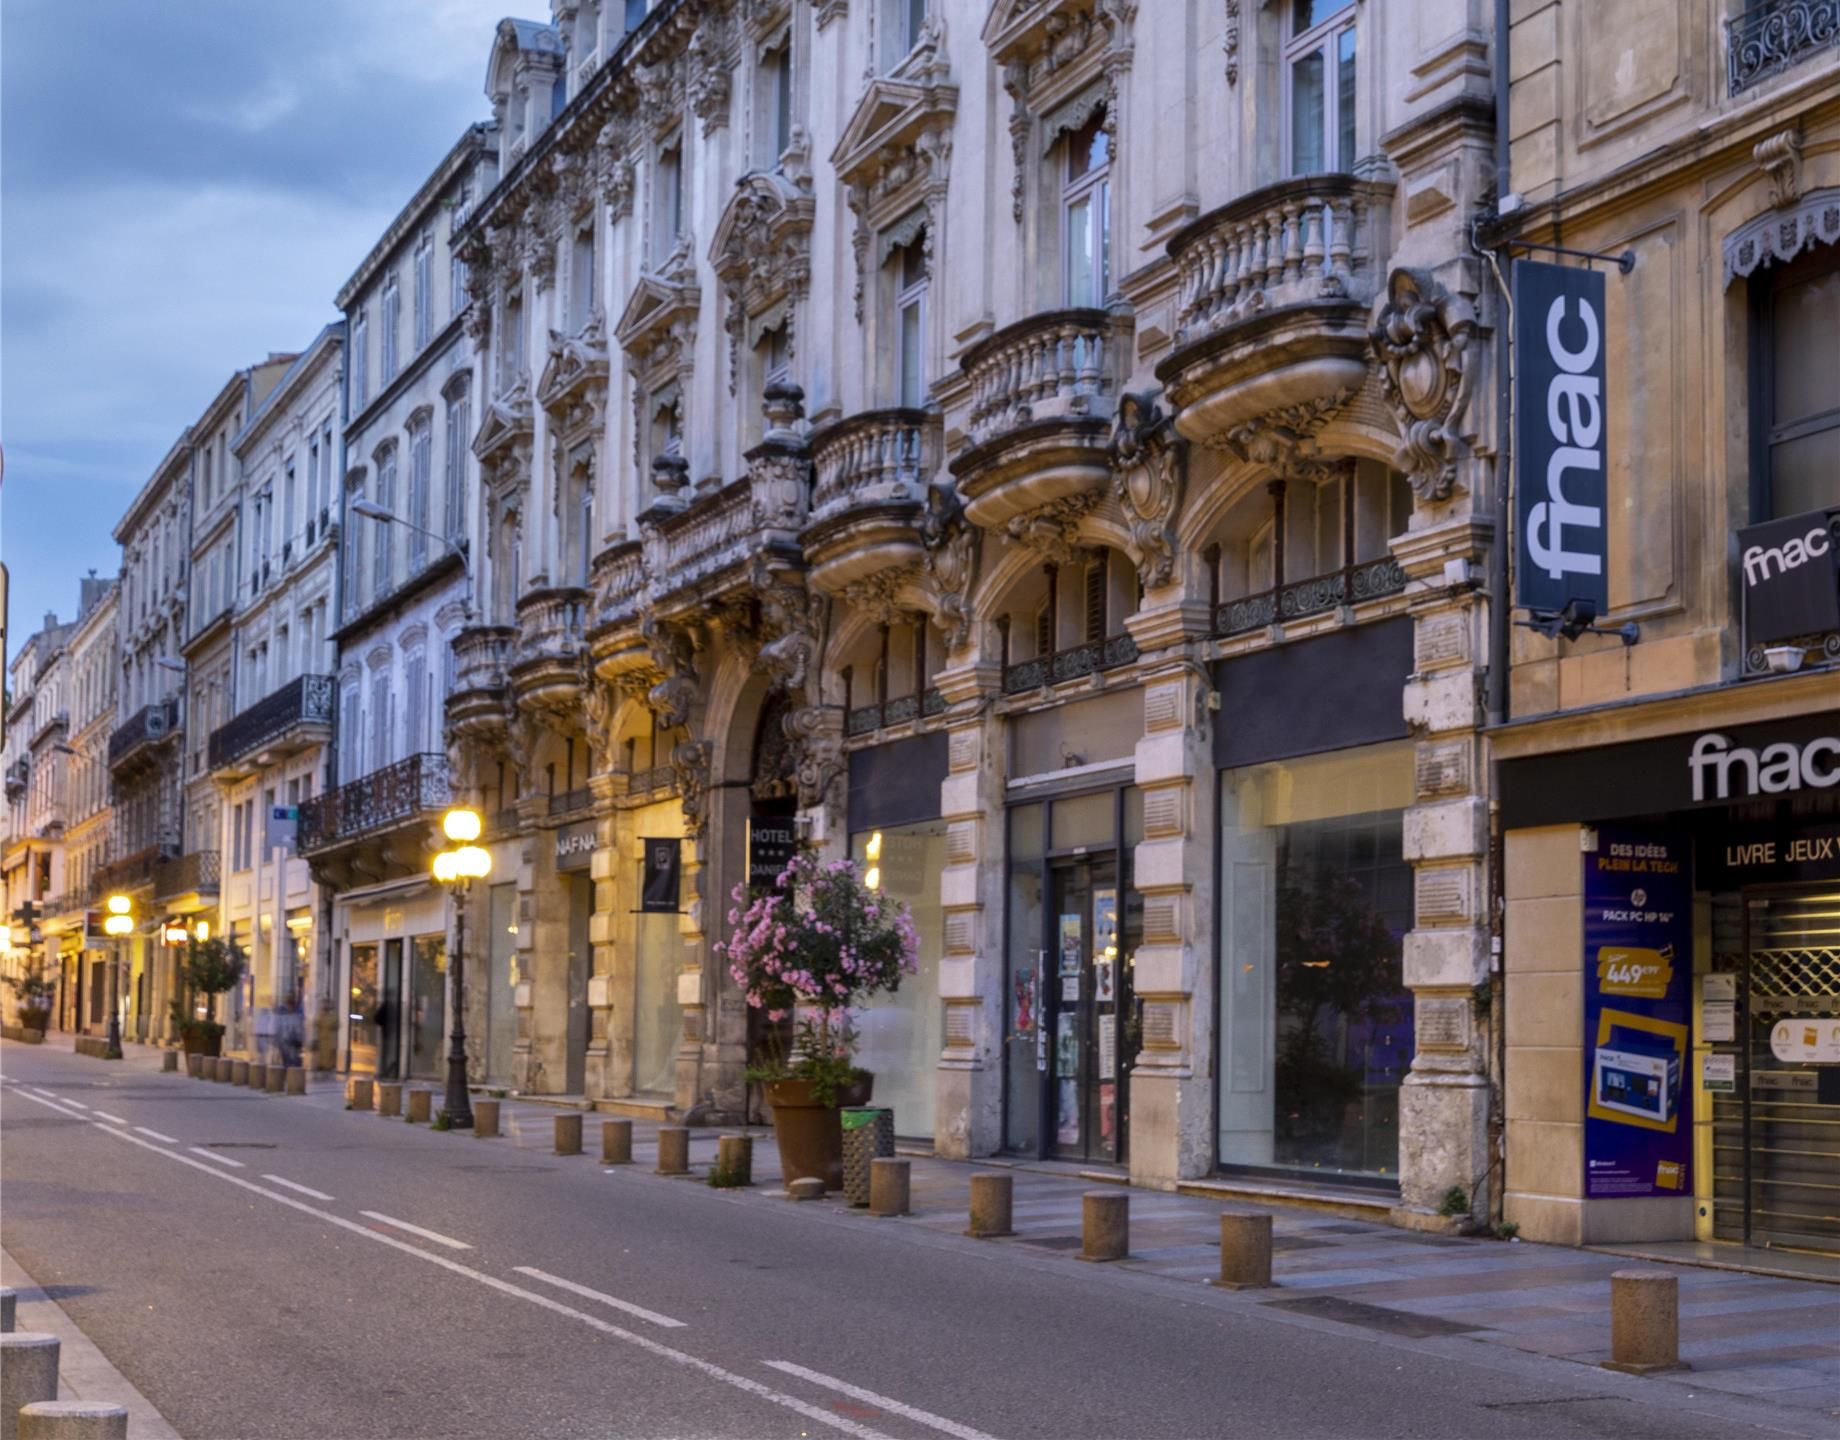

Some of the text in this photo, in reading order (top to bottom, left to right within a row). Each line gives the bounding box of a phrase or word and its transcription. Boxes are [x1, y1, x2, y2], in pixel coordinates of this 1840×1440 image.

[1527, 295, 1602, 580] fnac
[1744, 527, 1830, 587] fnac
[1688, 733, 1840, 801] fnac
[579, 833, 599, 852] NA
[1610, 842, 1667, 858] DES IDÉES
[1727, 842, 1777, 867] LIVRE
[1785, 838, 1833, 862] JEUX
[1598, 858, 1679, 873] PLEIN LA TECH
[1603, 910, 1628, 921] PACK
[1629, 911, 1644, 922] PC
[1644, 912, 1658, 922] HP
